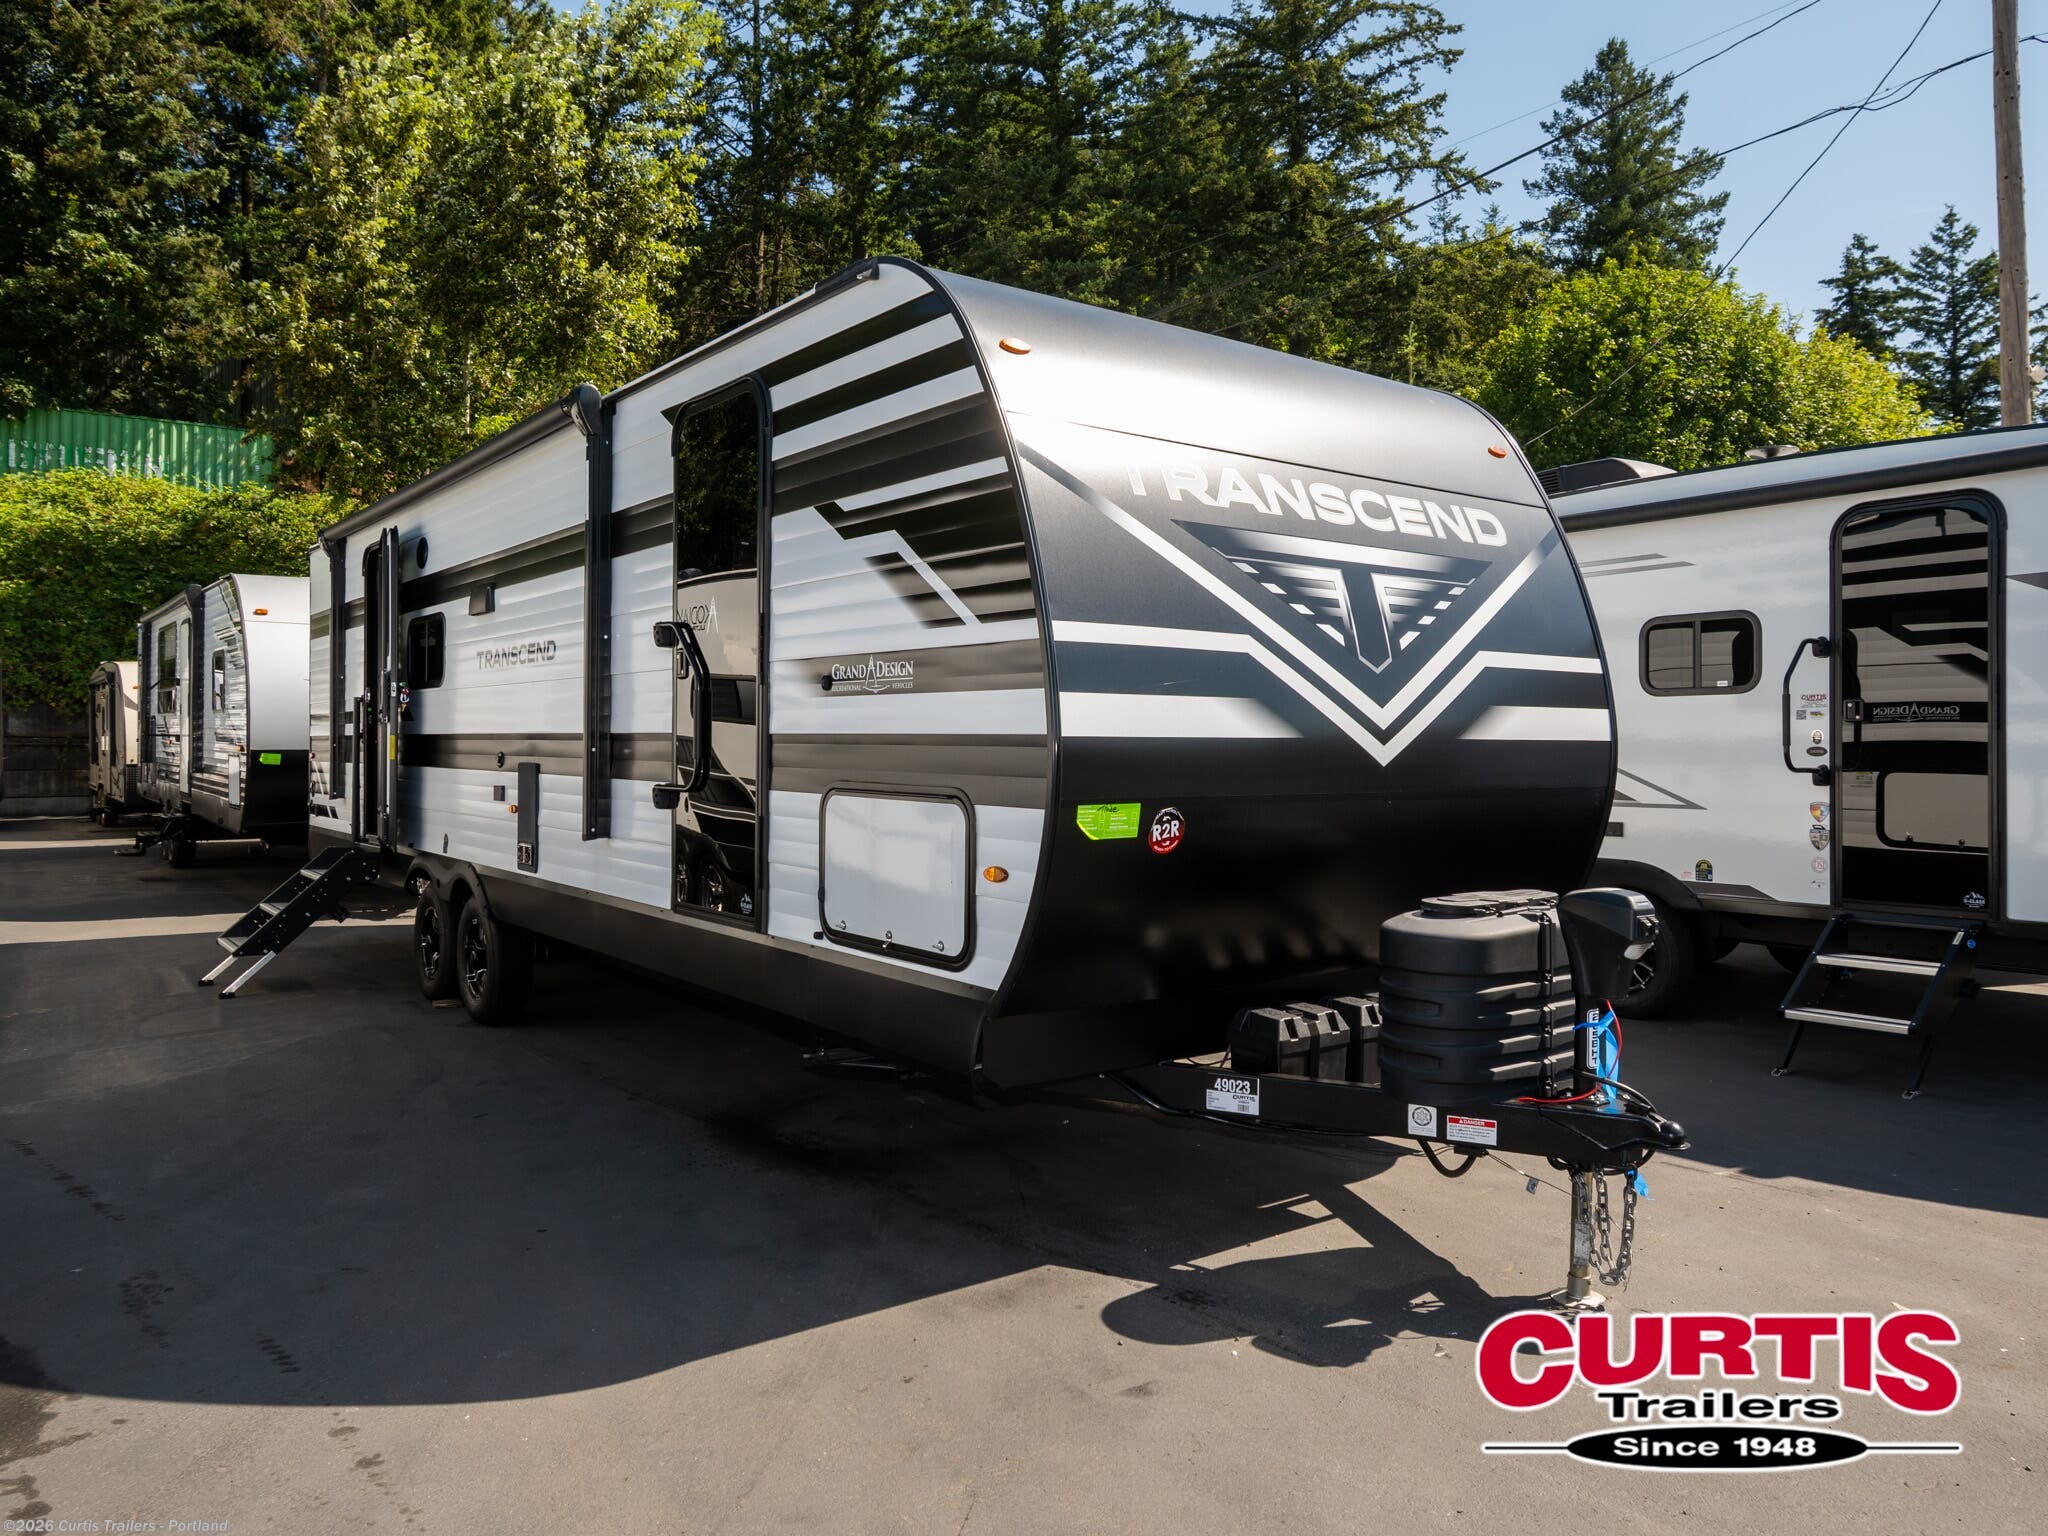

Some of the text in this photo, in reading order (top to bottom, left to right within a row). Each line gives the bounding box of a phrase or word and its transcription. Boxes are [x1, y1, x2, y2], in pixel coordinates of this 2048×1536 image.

[1123, 462, 1508, 547] TRANSCEND
[476, 640, 557, 669] TRANSCEND
[832, 661, 914, 680] GRAND DESIGN
[1152, 820, 1180, 842] R2R
[1214, 1077, 1251, 1095] 49023
